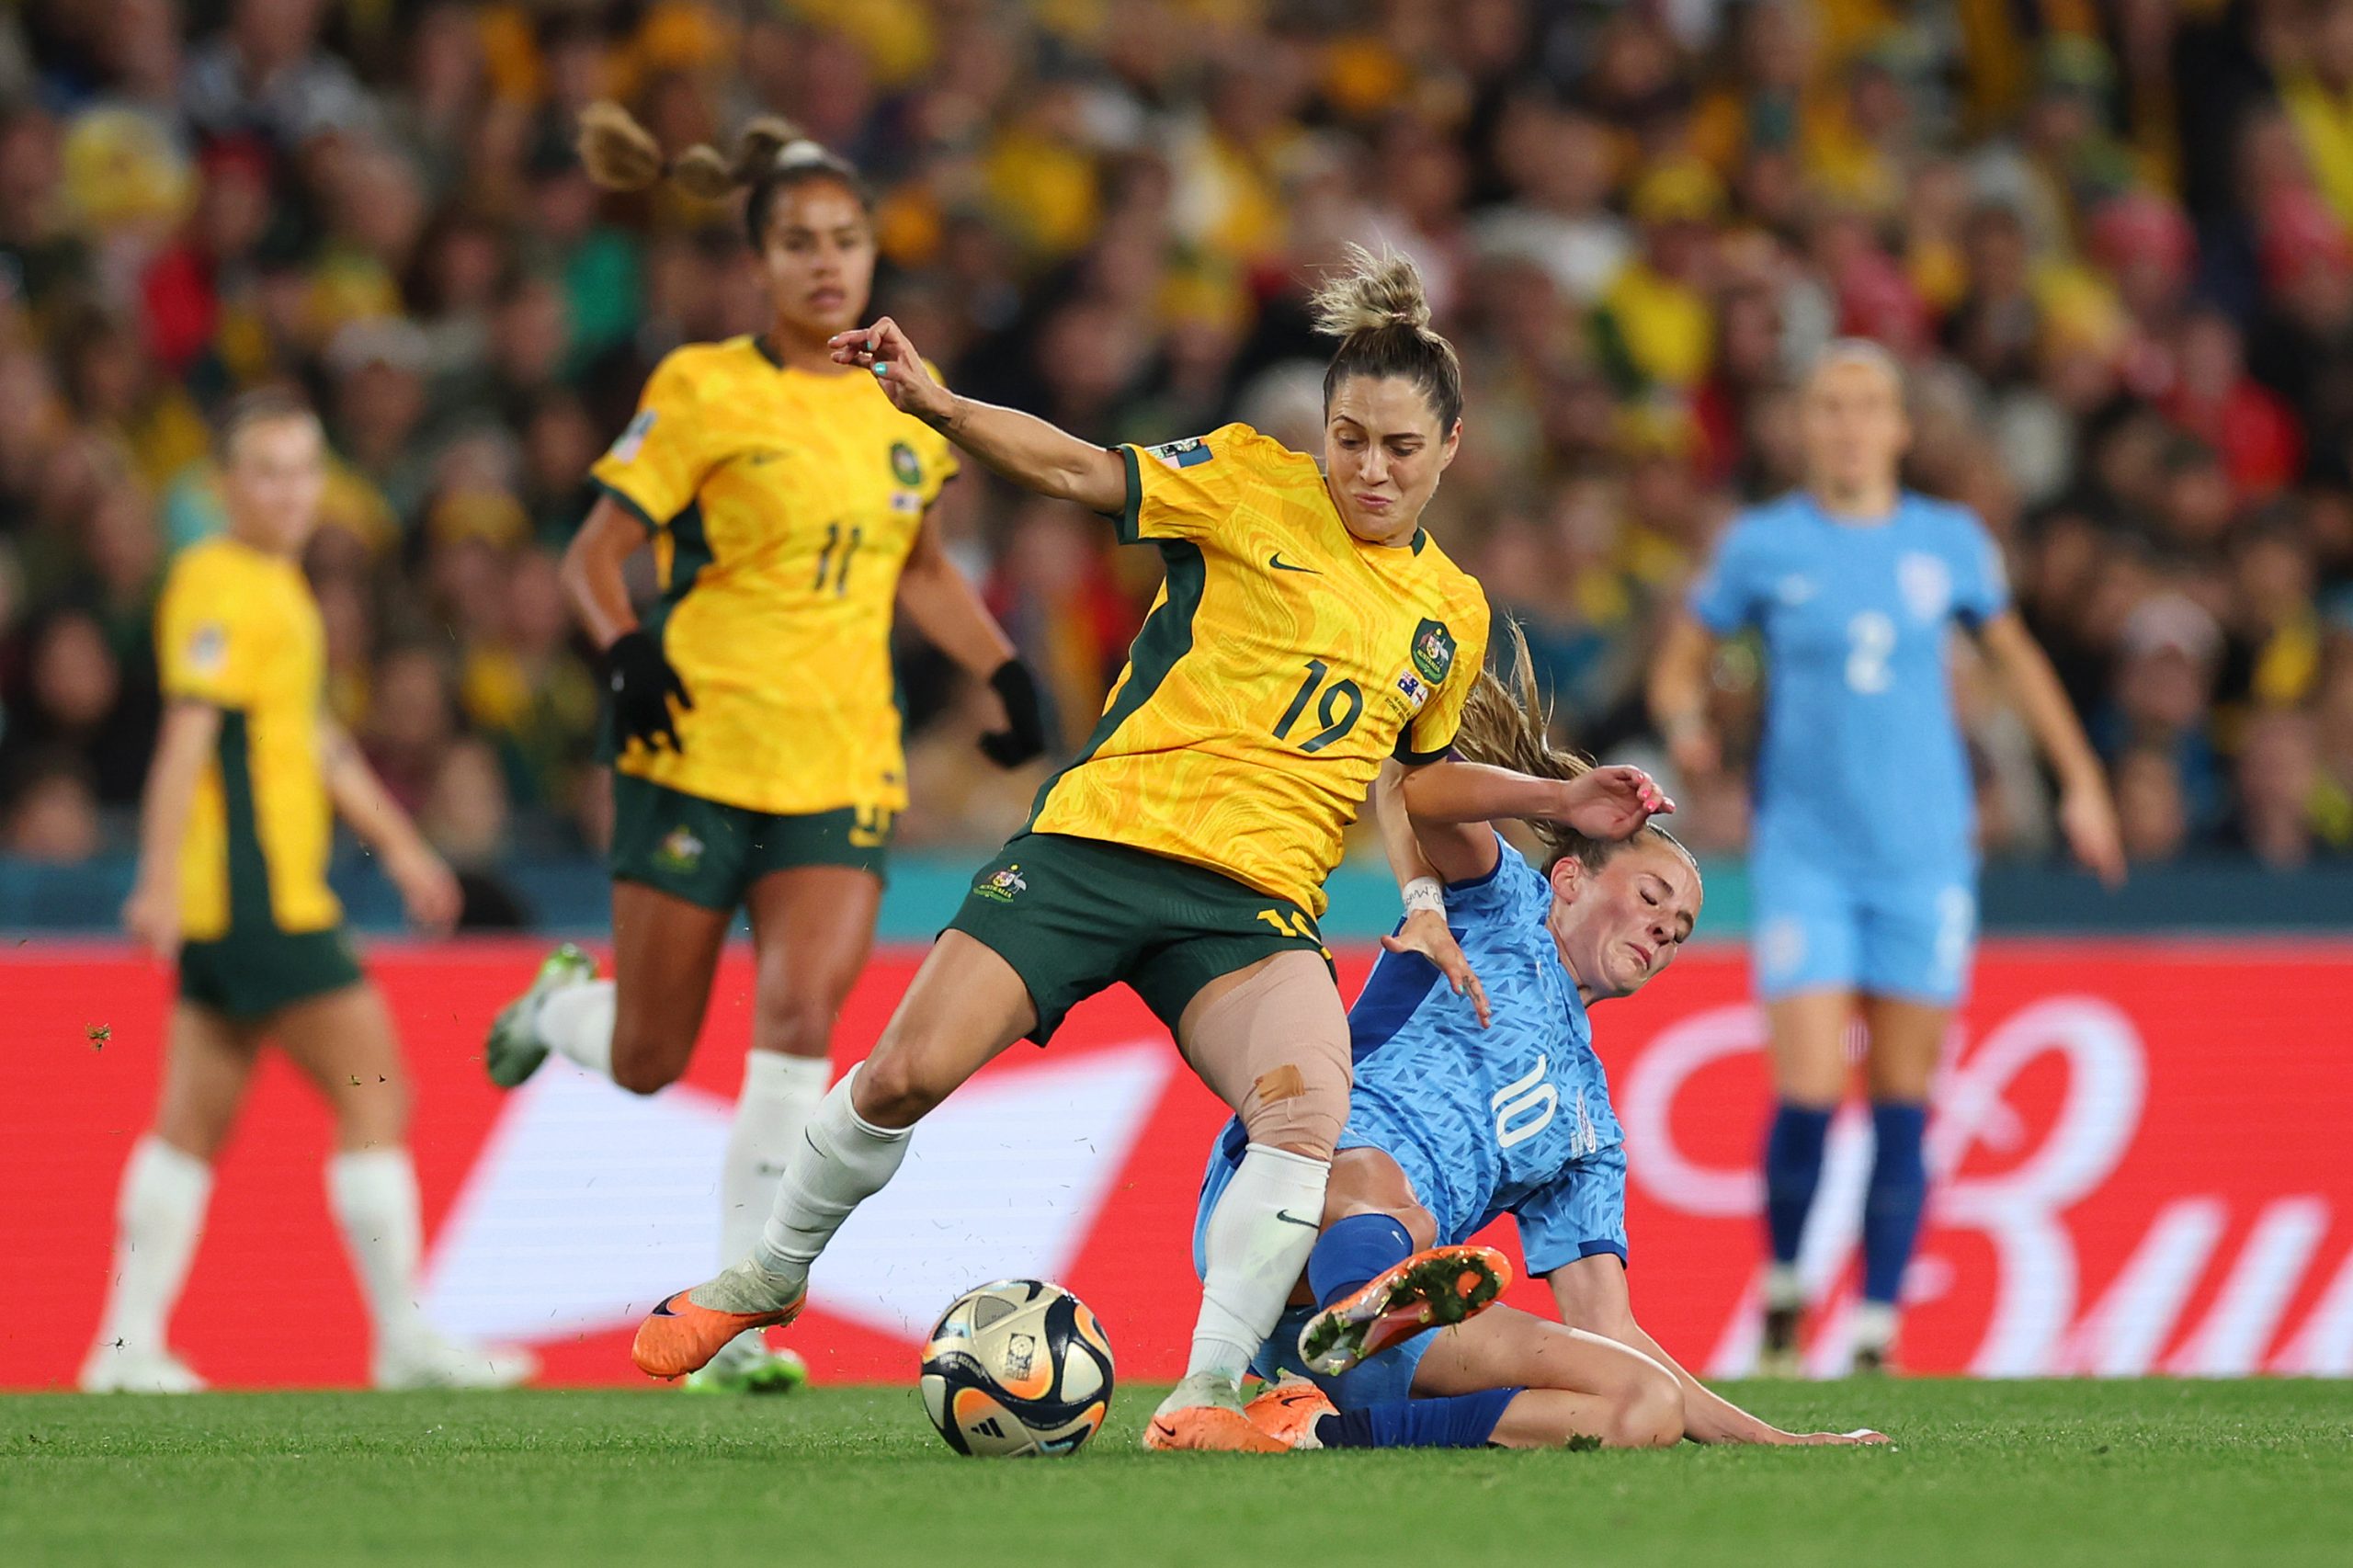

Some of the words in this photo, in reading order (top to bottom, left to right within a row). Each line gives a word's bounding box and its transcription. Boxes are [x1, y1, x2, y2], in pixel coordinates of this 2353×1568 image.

[814, 523, 861, 597] 11
[1844, 610, 1896, 695] 2
[1272, 658, 1363, 753] 19
[1492, 1054, 1559, 1148] 10
